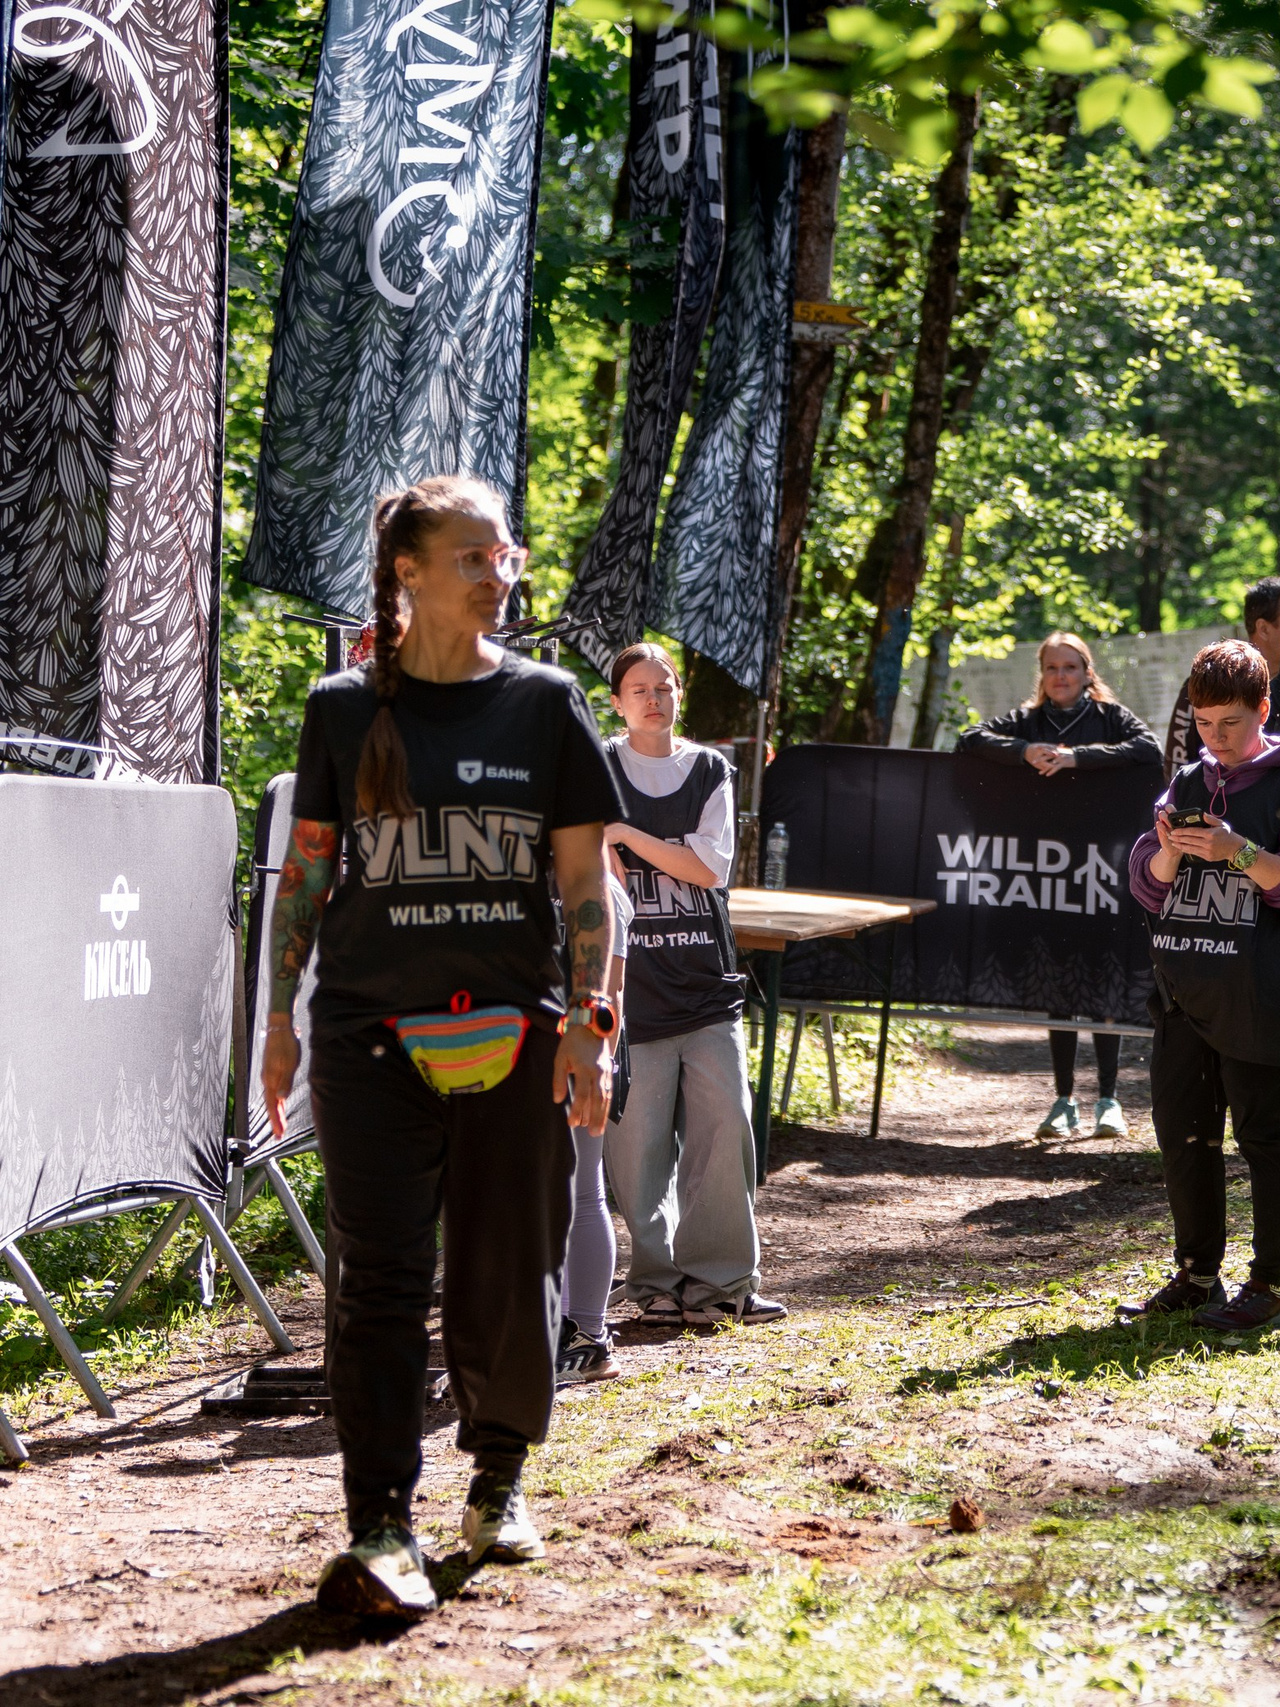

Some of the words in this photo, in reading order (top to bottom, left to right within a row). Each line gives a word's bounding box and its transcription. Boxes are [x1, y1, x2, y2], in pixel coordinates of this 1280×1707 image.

[485, 765, 531, 783] БАНК
[937, 834, 1071, 874] WILD
[936, 871, 1083, 915] TRAIL
[388, 903, 453, 927] WILD
[455, 901, 526, 924] TRAIL
[628, 933, 664, 948] WILD
[665, 931, 715, 947] TRAIL
[1152, 934, 1192, 952] WILD
[1193, 937, 1239, 955] TRAIL
[84, 939, 152, 1001] КИСЕЛЬ
